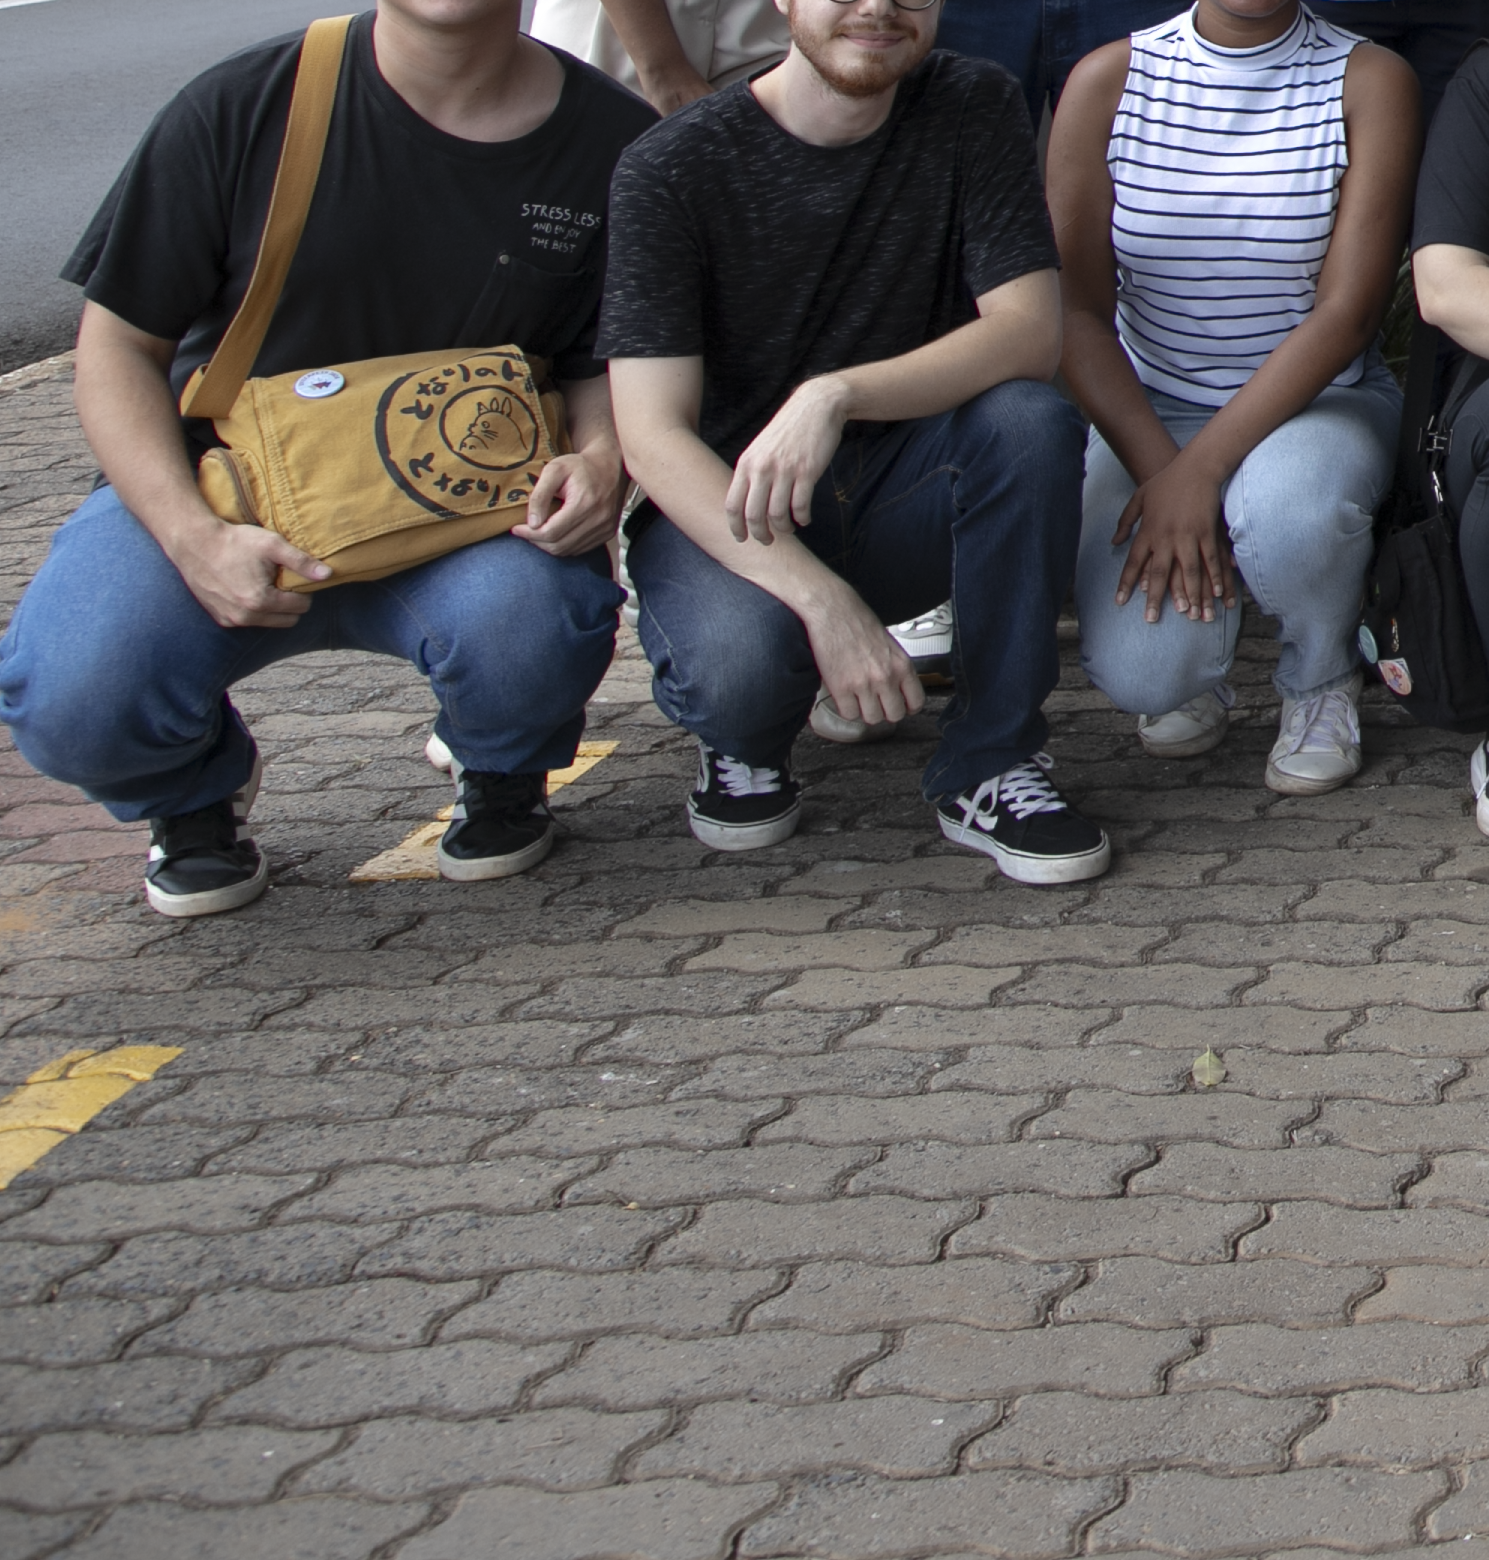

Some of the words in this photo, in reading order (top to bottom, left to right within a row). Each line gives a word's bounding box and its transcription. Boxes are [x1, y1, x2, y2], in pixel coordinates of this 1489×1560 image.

[521, 203, 572, 221] STRESS
[532, 222, 552, 234] AND
[531, 236, 549, 249] THE
[551, 240, 577, 253] BEST
